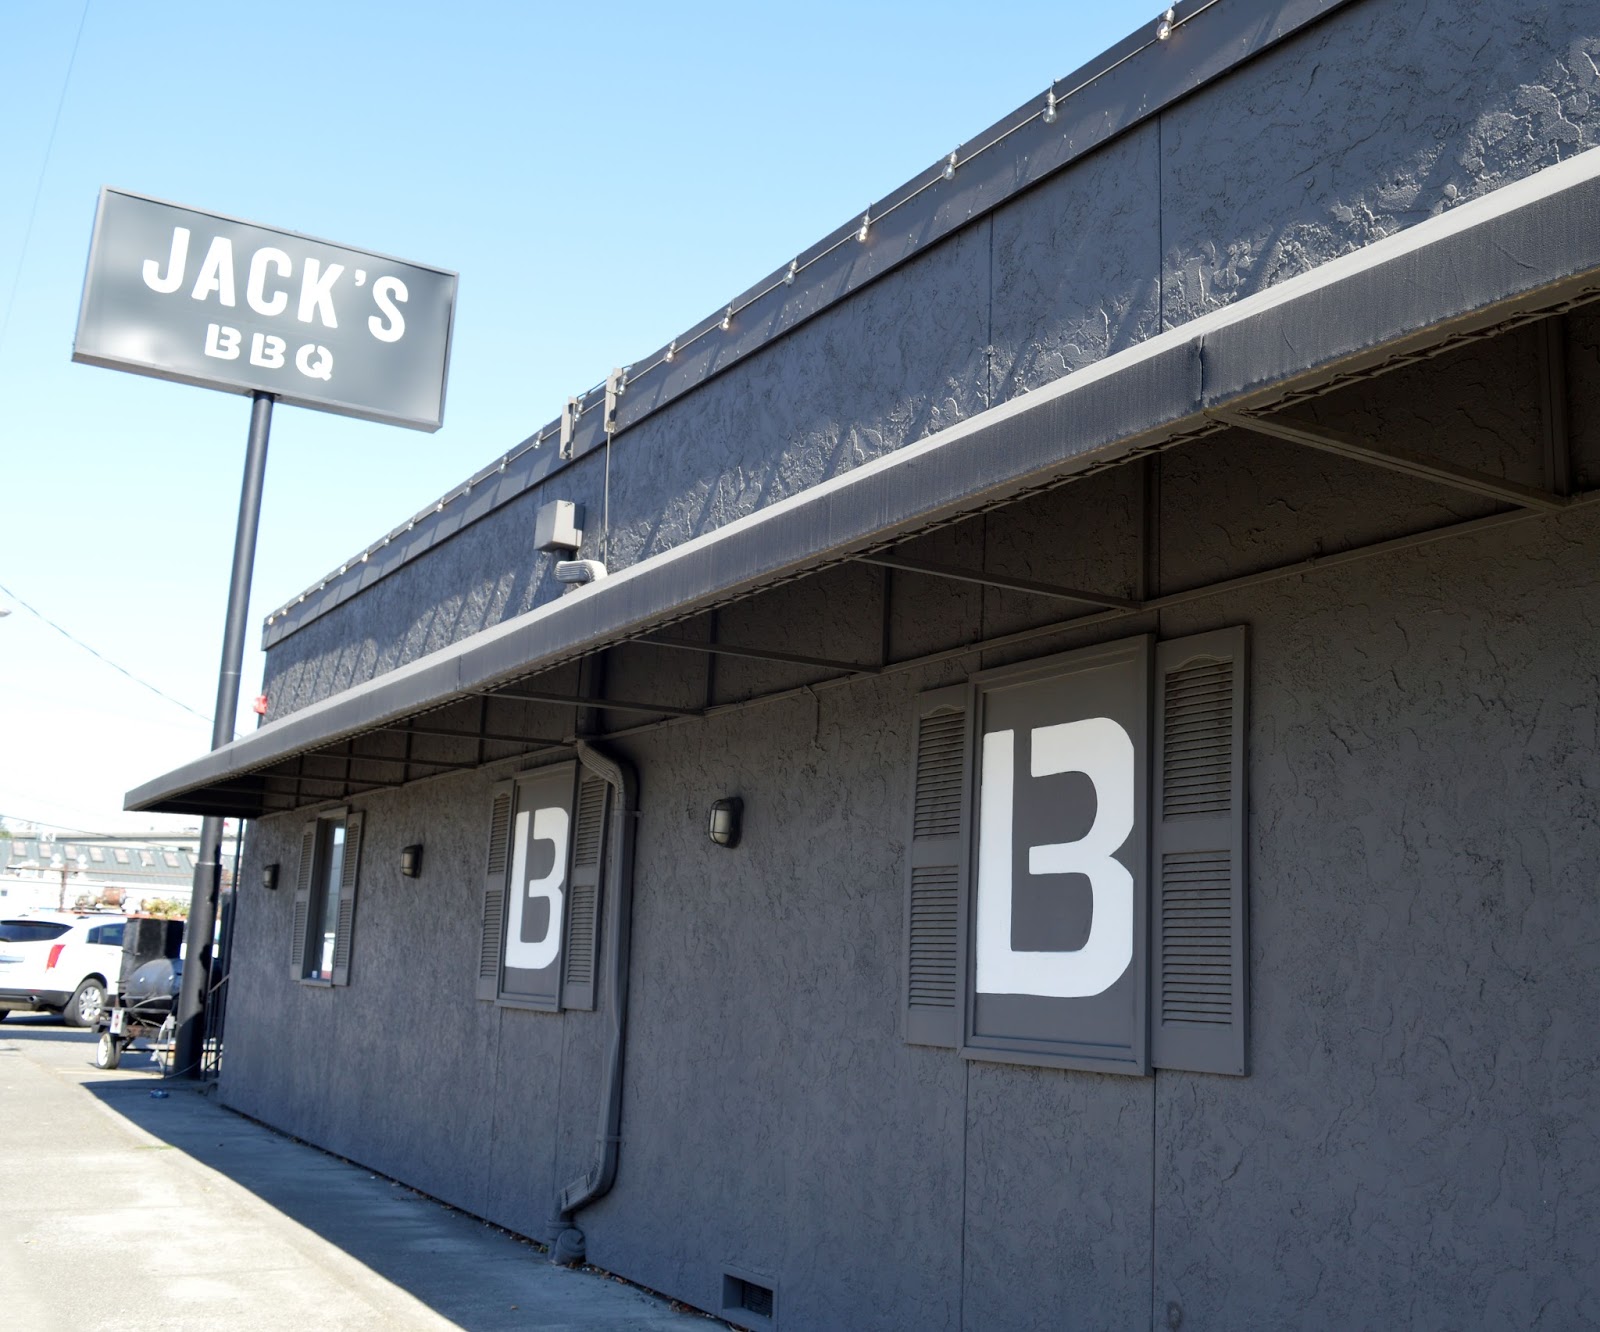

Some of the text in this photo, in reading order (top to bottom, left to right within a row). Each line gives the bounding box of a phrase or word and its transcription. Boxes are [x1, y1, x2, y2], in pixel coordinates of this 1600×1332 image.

[142, 226, 409, 344] JACK'S
[204, 323, 334, 381] BBQ
[504, 806, 569, 971] B
[976, 716, 1136, 998] B
